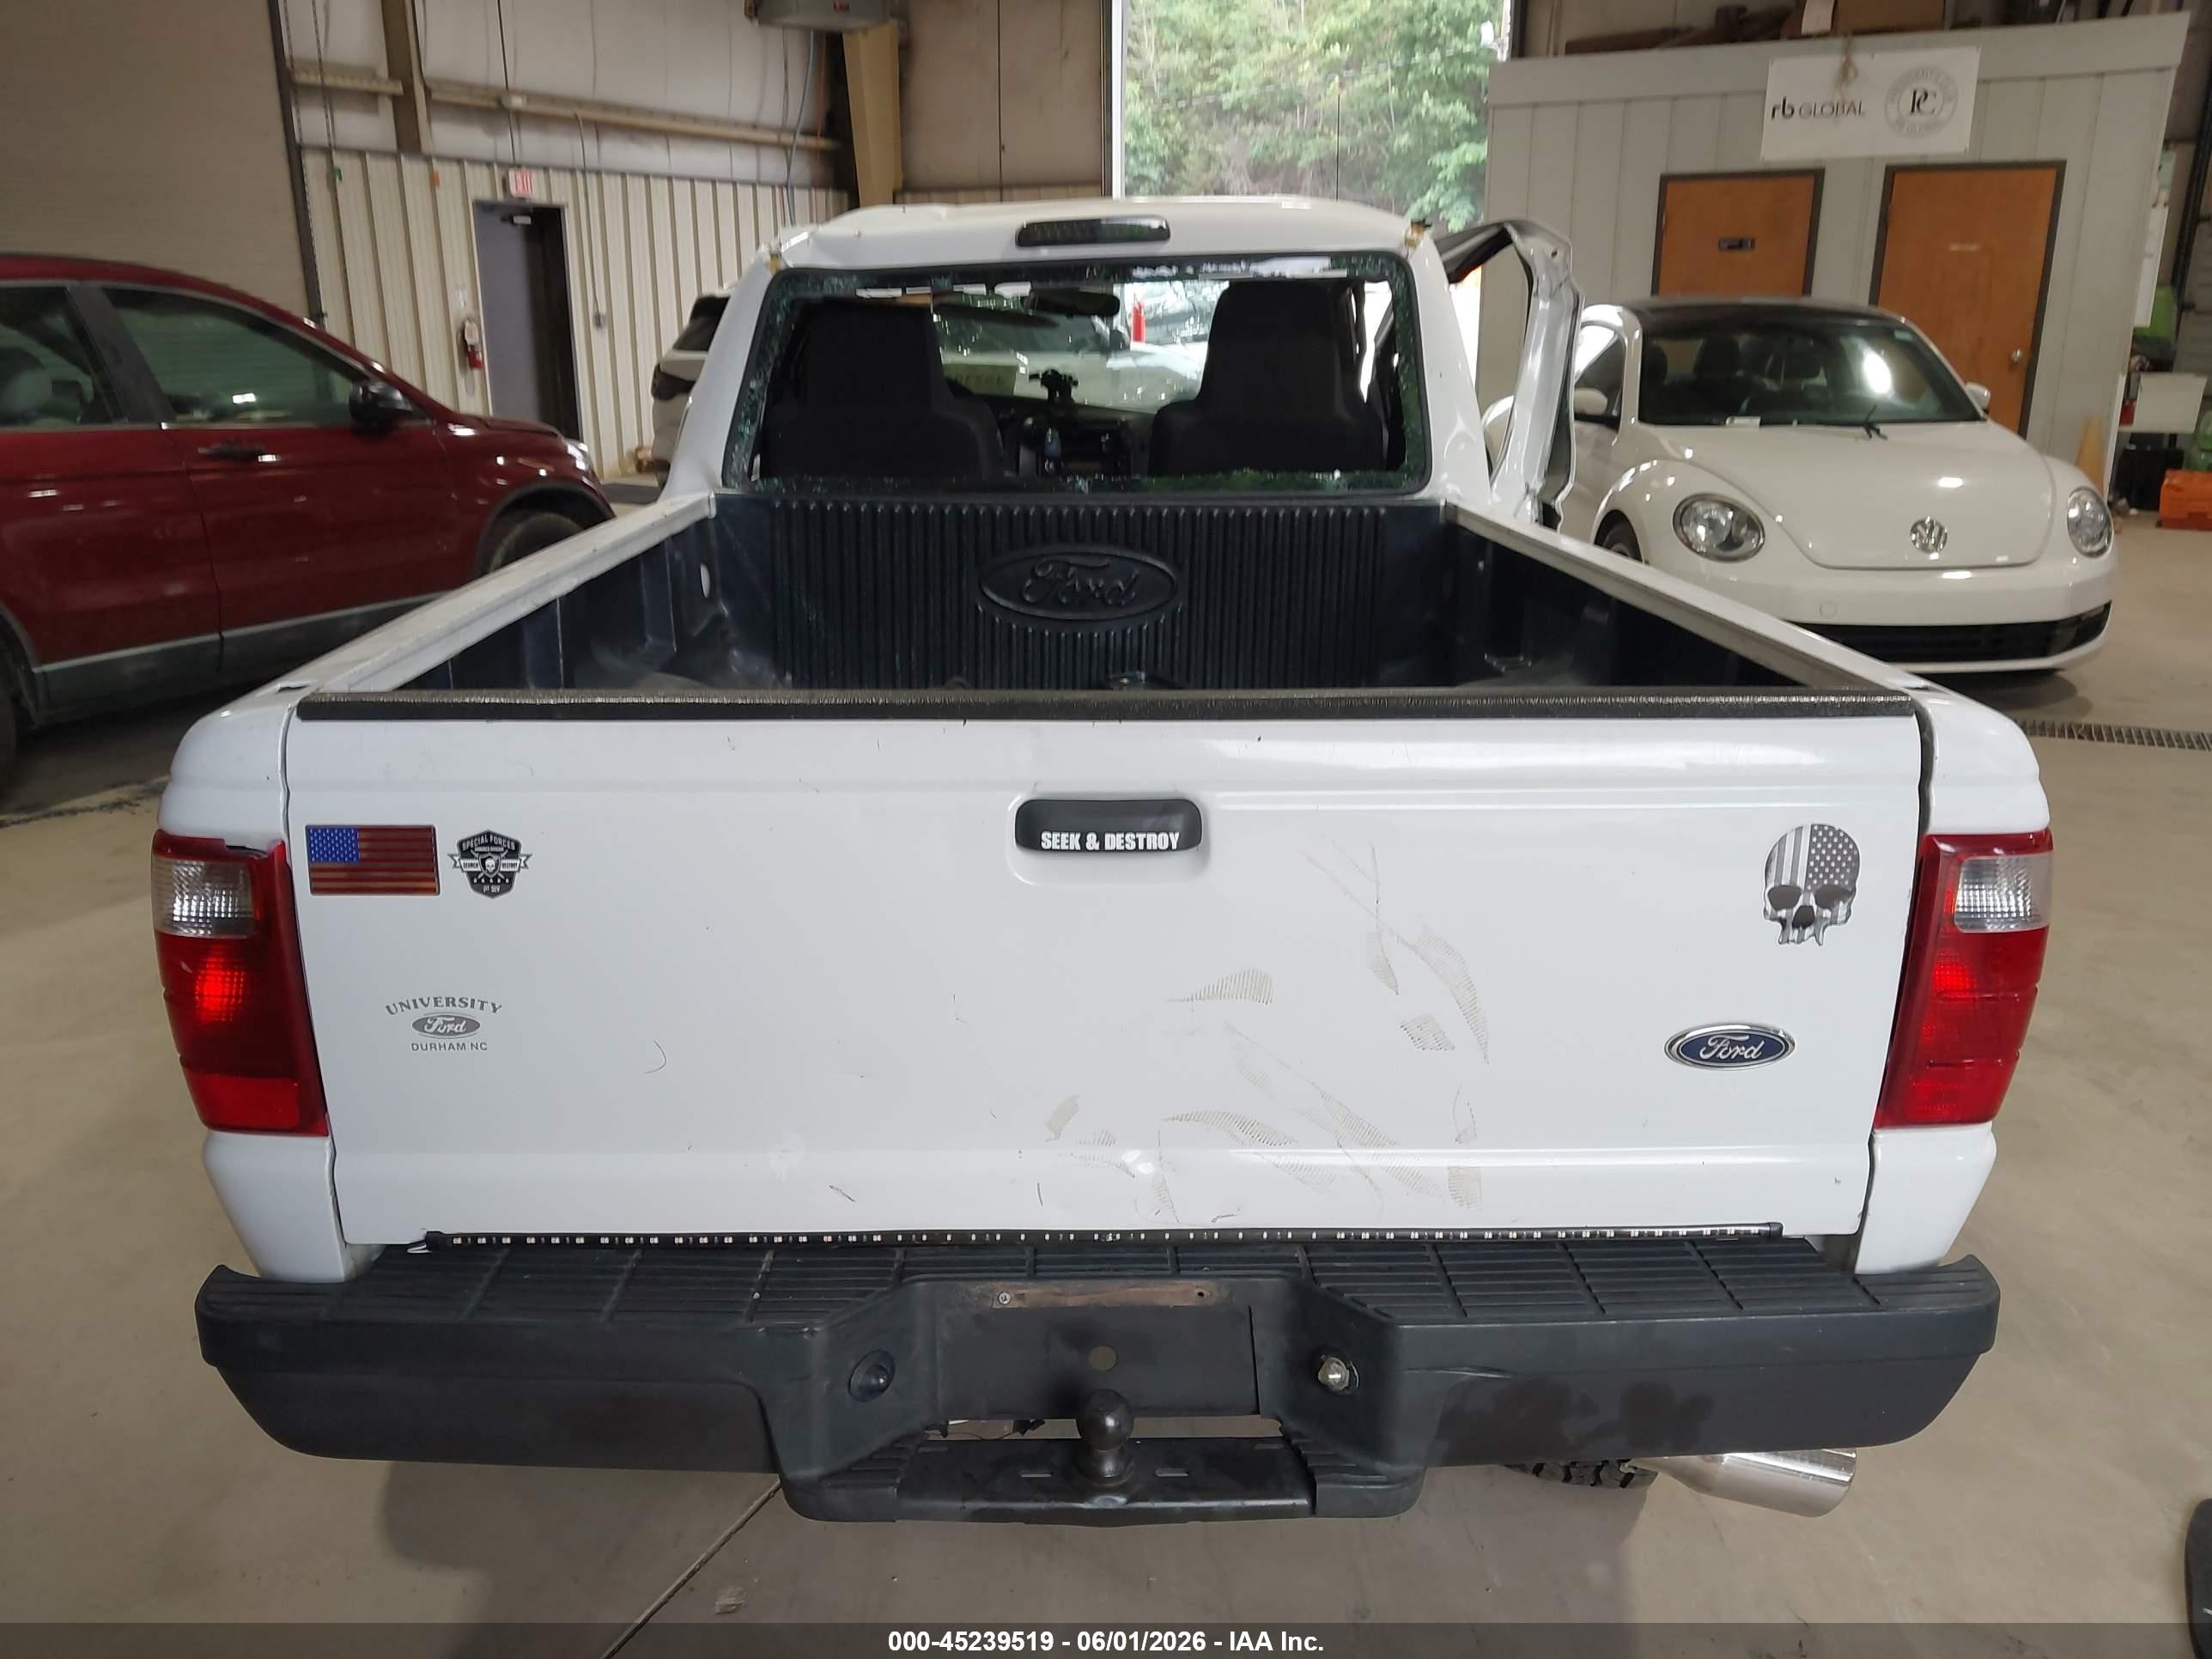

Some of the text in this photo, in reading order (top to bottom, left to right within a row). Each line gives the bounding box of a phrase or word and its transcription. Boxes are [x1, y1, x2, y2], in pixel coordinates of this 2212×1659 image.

[1771, 95, 1866, 120] rb GLOBAL
[1022, 556, 1139, 605] Ford
[462, 834, 516, 851] SPECIAL FORCES
[1041, 831, 1180, 851] SEEK & DESTROY
[385, 996, 502, 1015] UNIVERSITY
[424, 1017, 467, 1033] Ford
[411, 1042, 488, 1052] DURHAM NC
[1699, 1035, 1765, 1059] Ford
